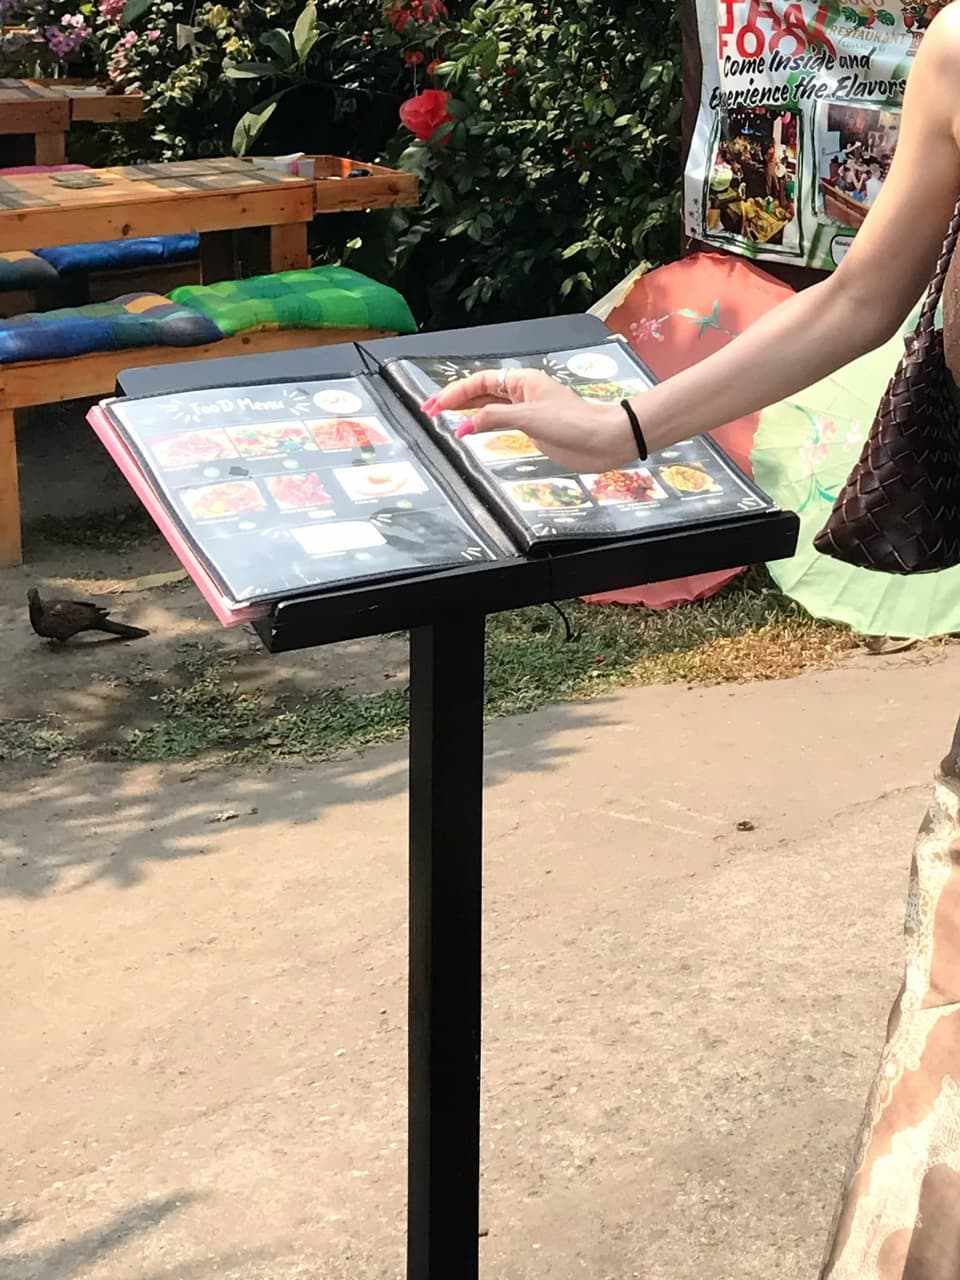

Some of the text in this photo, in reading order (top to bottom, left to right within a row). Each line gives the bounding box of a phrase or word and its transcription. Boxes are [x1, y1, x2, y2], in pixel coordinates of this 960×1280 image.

[723, 53, 765, 78] Come
[768, 46, 835, 72] Inside
[838, 46, 877, 71] and
[790, 74, 828, 103] the
[831, 74, 908, 102] Flavors
